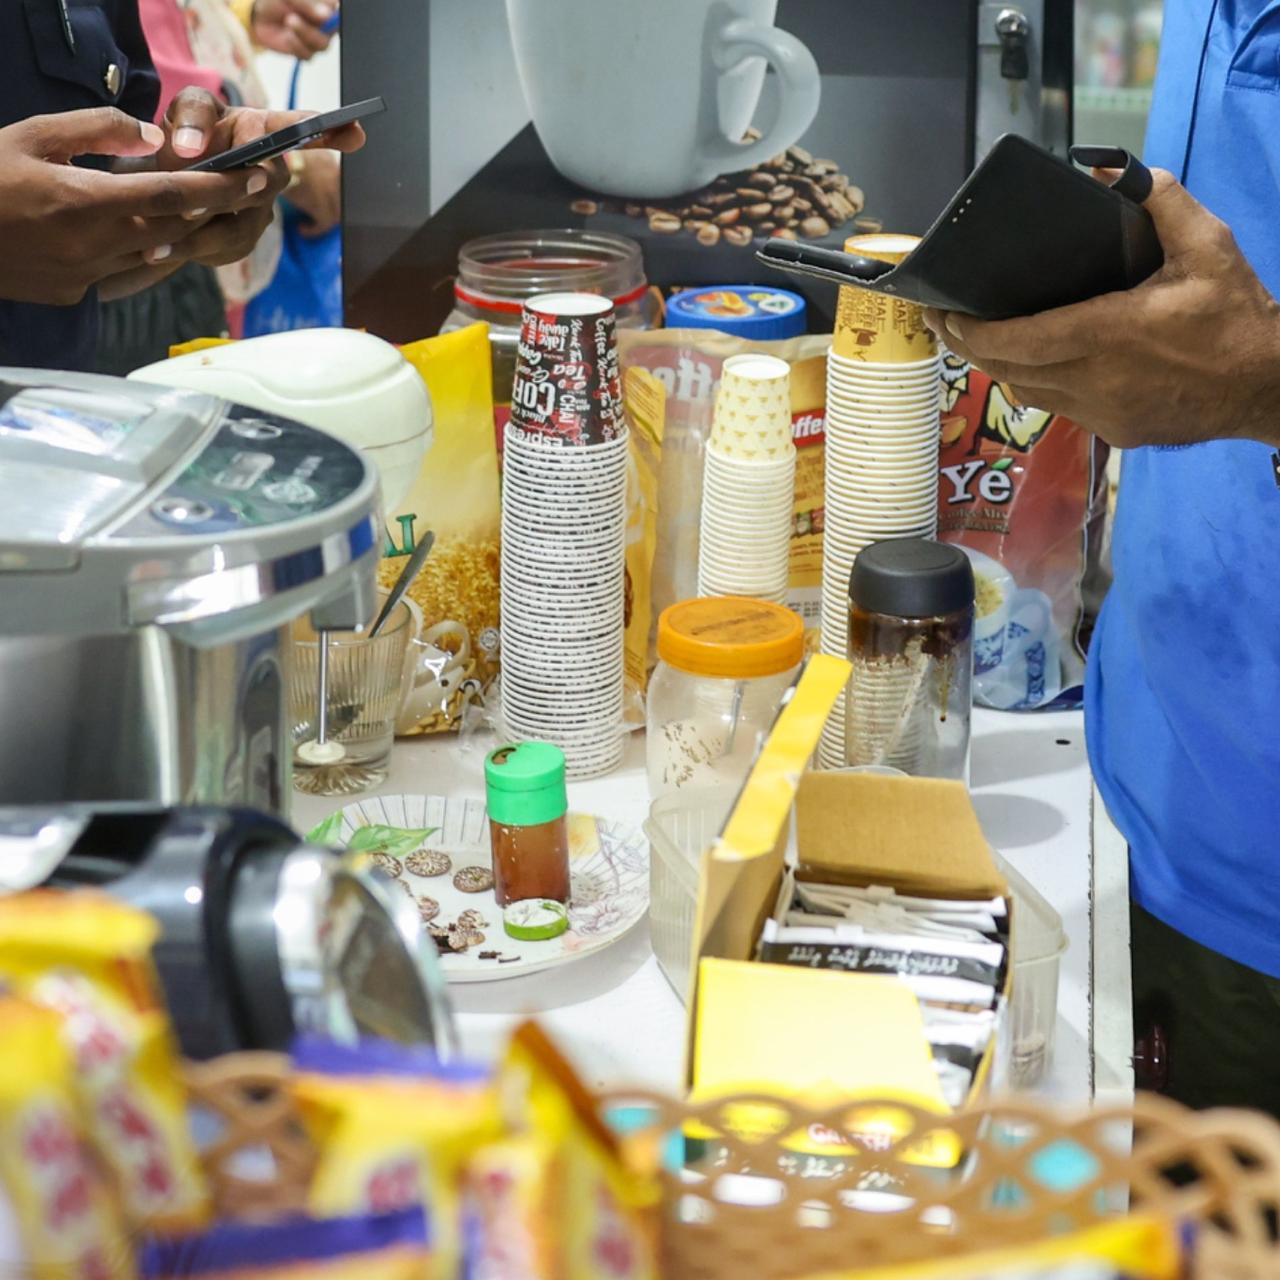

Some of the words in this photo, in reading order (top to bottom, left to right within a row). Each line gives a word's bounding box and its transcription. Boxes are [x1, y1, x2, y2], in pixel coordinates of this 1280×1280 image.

[539, 333, 566, 352] Take
[553, 363, 587, 382] Tea
[559, 394, 576, 423] CHAI
[940, 457, 1014, 504] Yé
